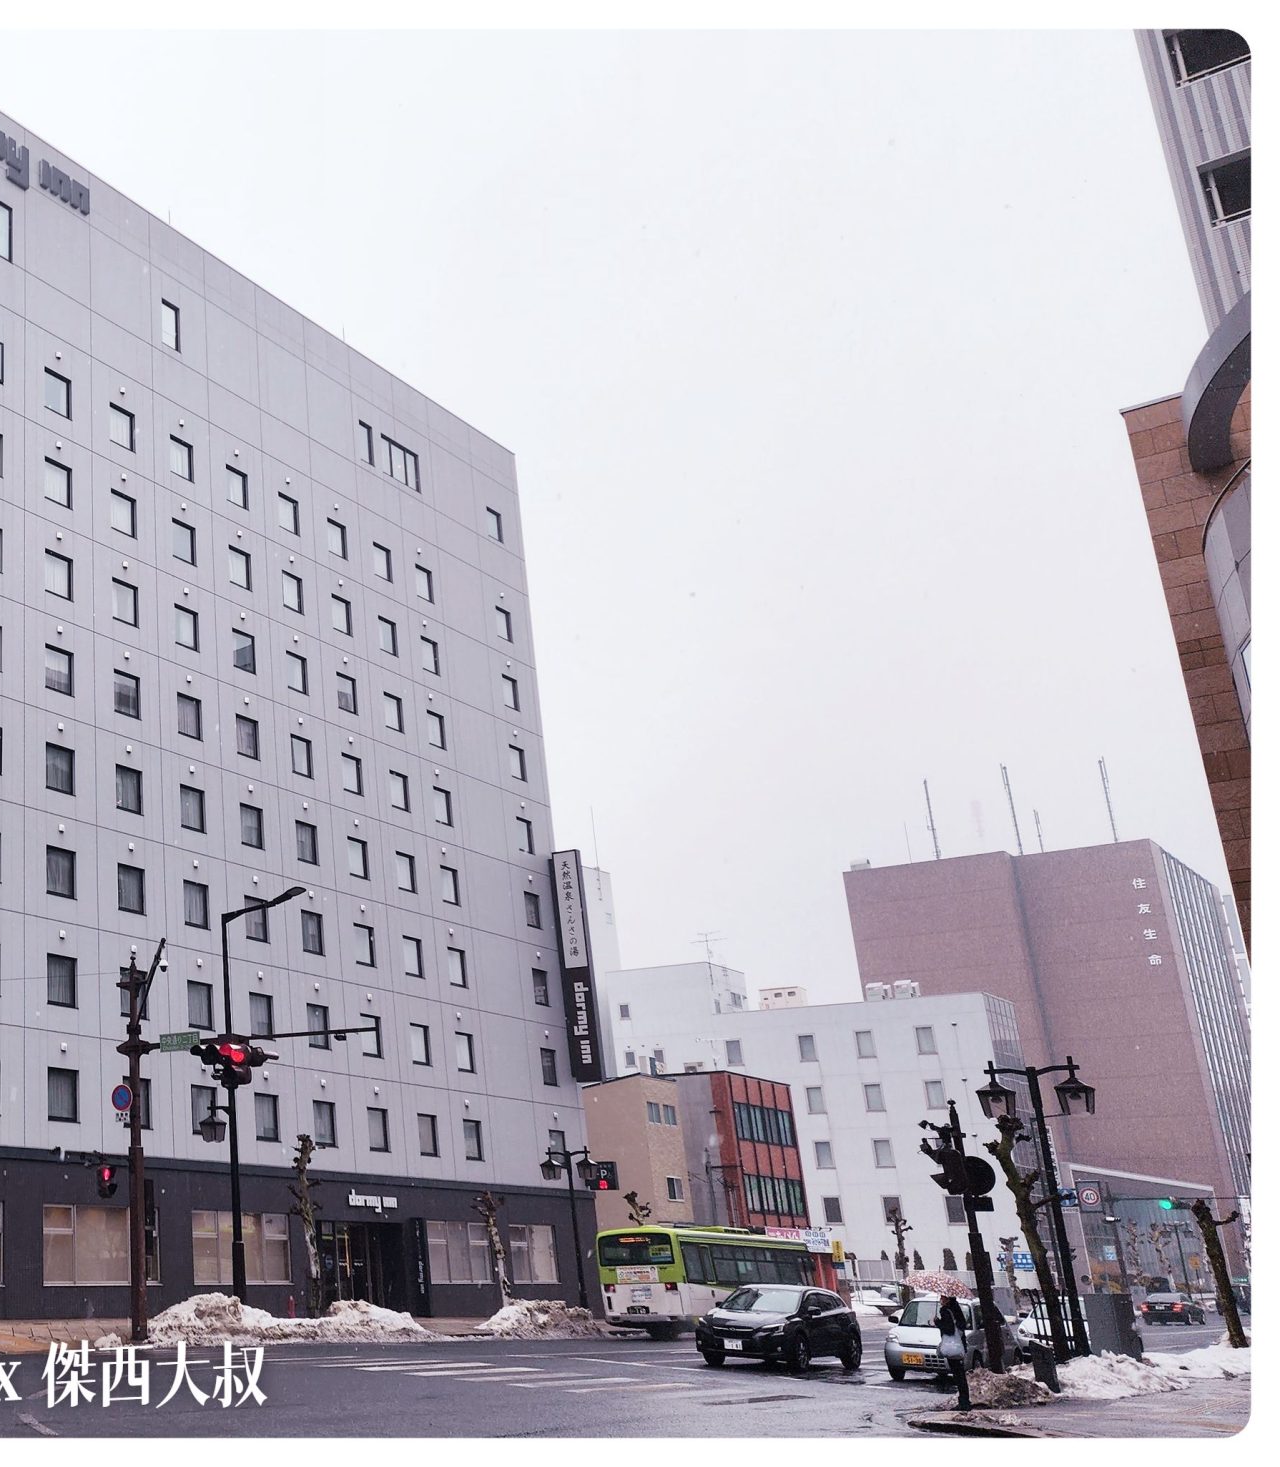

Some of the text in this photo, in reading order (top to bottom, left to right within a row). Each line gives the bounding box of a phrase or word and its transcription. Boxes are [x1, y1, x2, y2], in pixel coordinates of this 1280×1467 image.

[39, 158, 90, 217] inn
[1132, 877, 1162, 966] 住友生命
[573, 981, 593, 1065] dormy inn
[348, 1188, 398, 1214] dormy inn
[1083, 1191, 1096, 1202] 40
